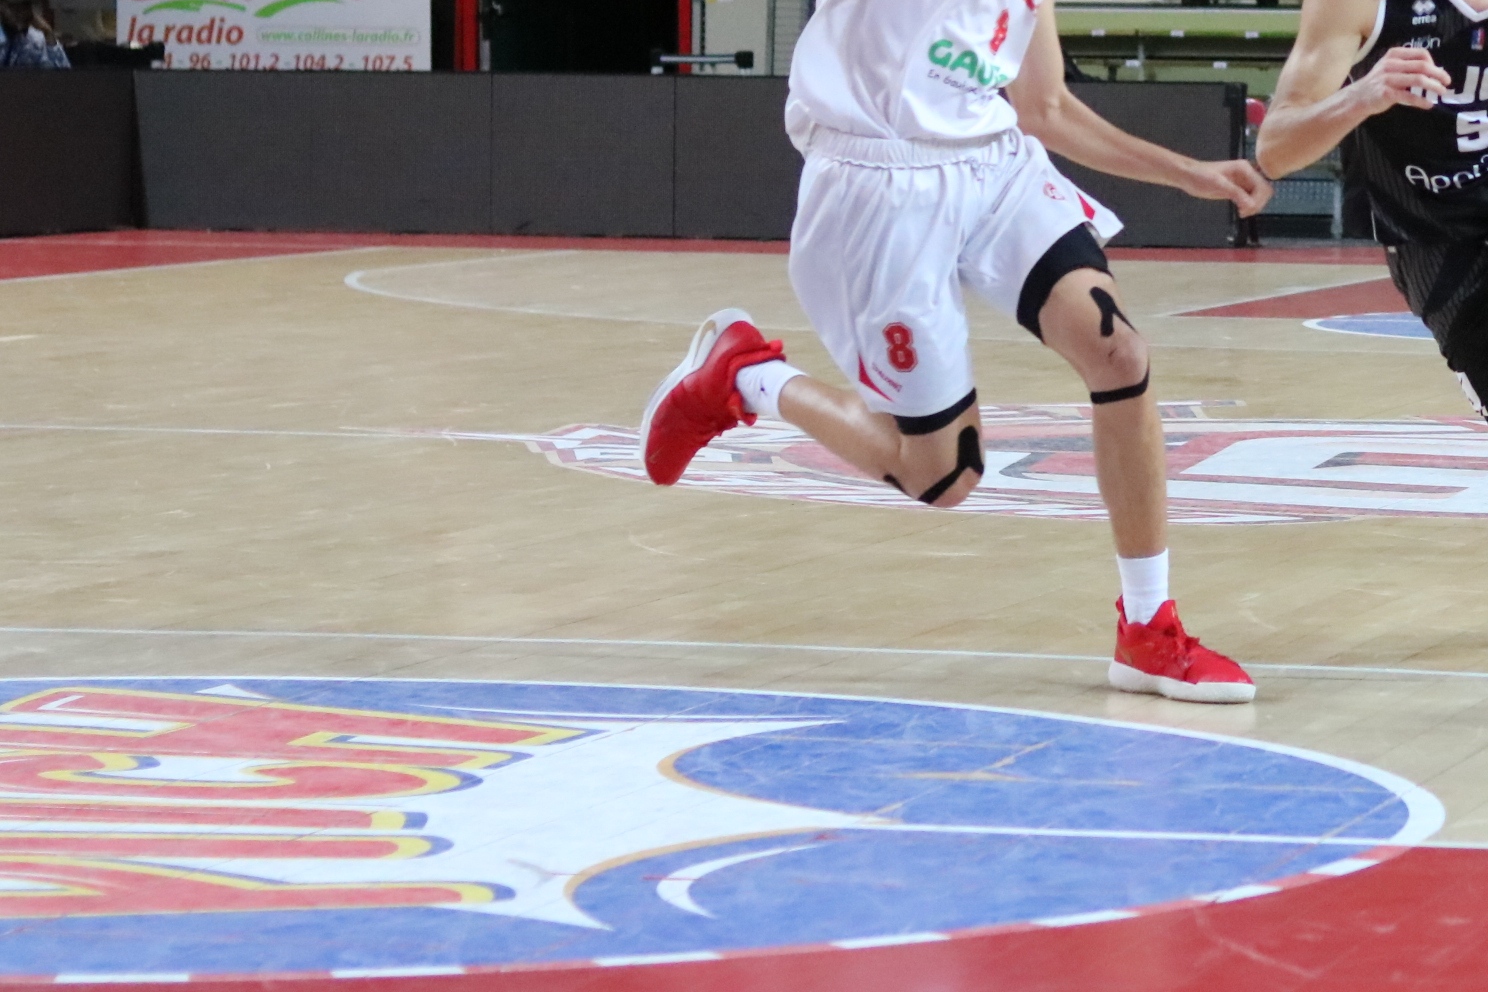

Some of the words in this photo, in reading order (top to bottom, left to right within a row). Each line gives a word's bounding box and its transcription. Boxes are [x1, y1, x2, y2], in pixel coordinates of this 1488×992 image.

[127, 16, 154, 46] la
[163, 16, 244, 45] radio
[188, 53, 211, 69] 96
[229, 53, 279, 69] 101.2
[294, 53, 343, 69] 104.2
[363, 53, 413, 69] 107.5
[882, 321, 918, 373] 8
